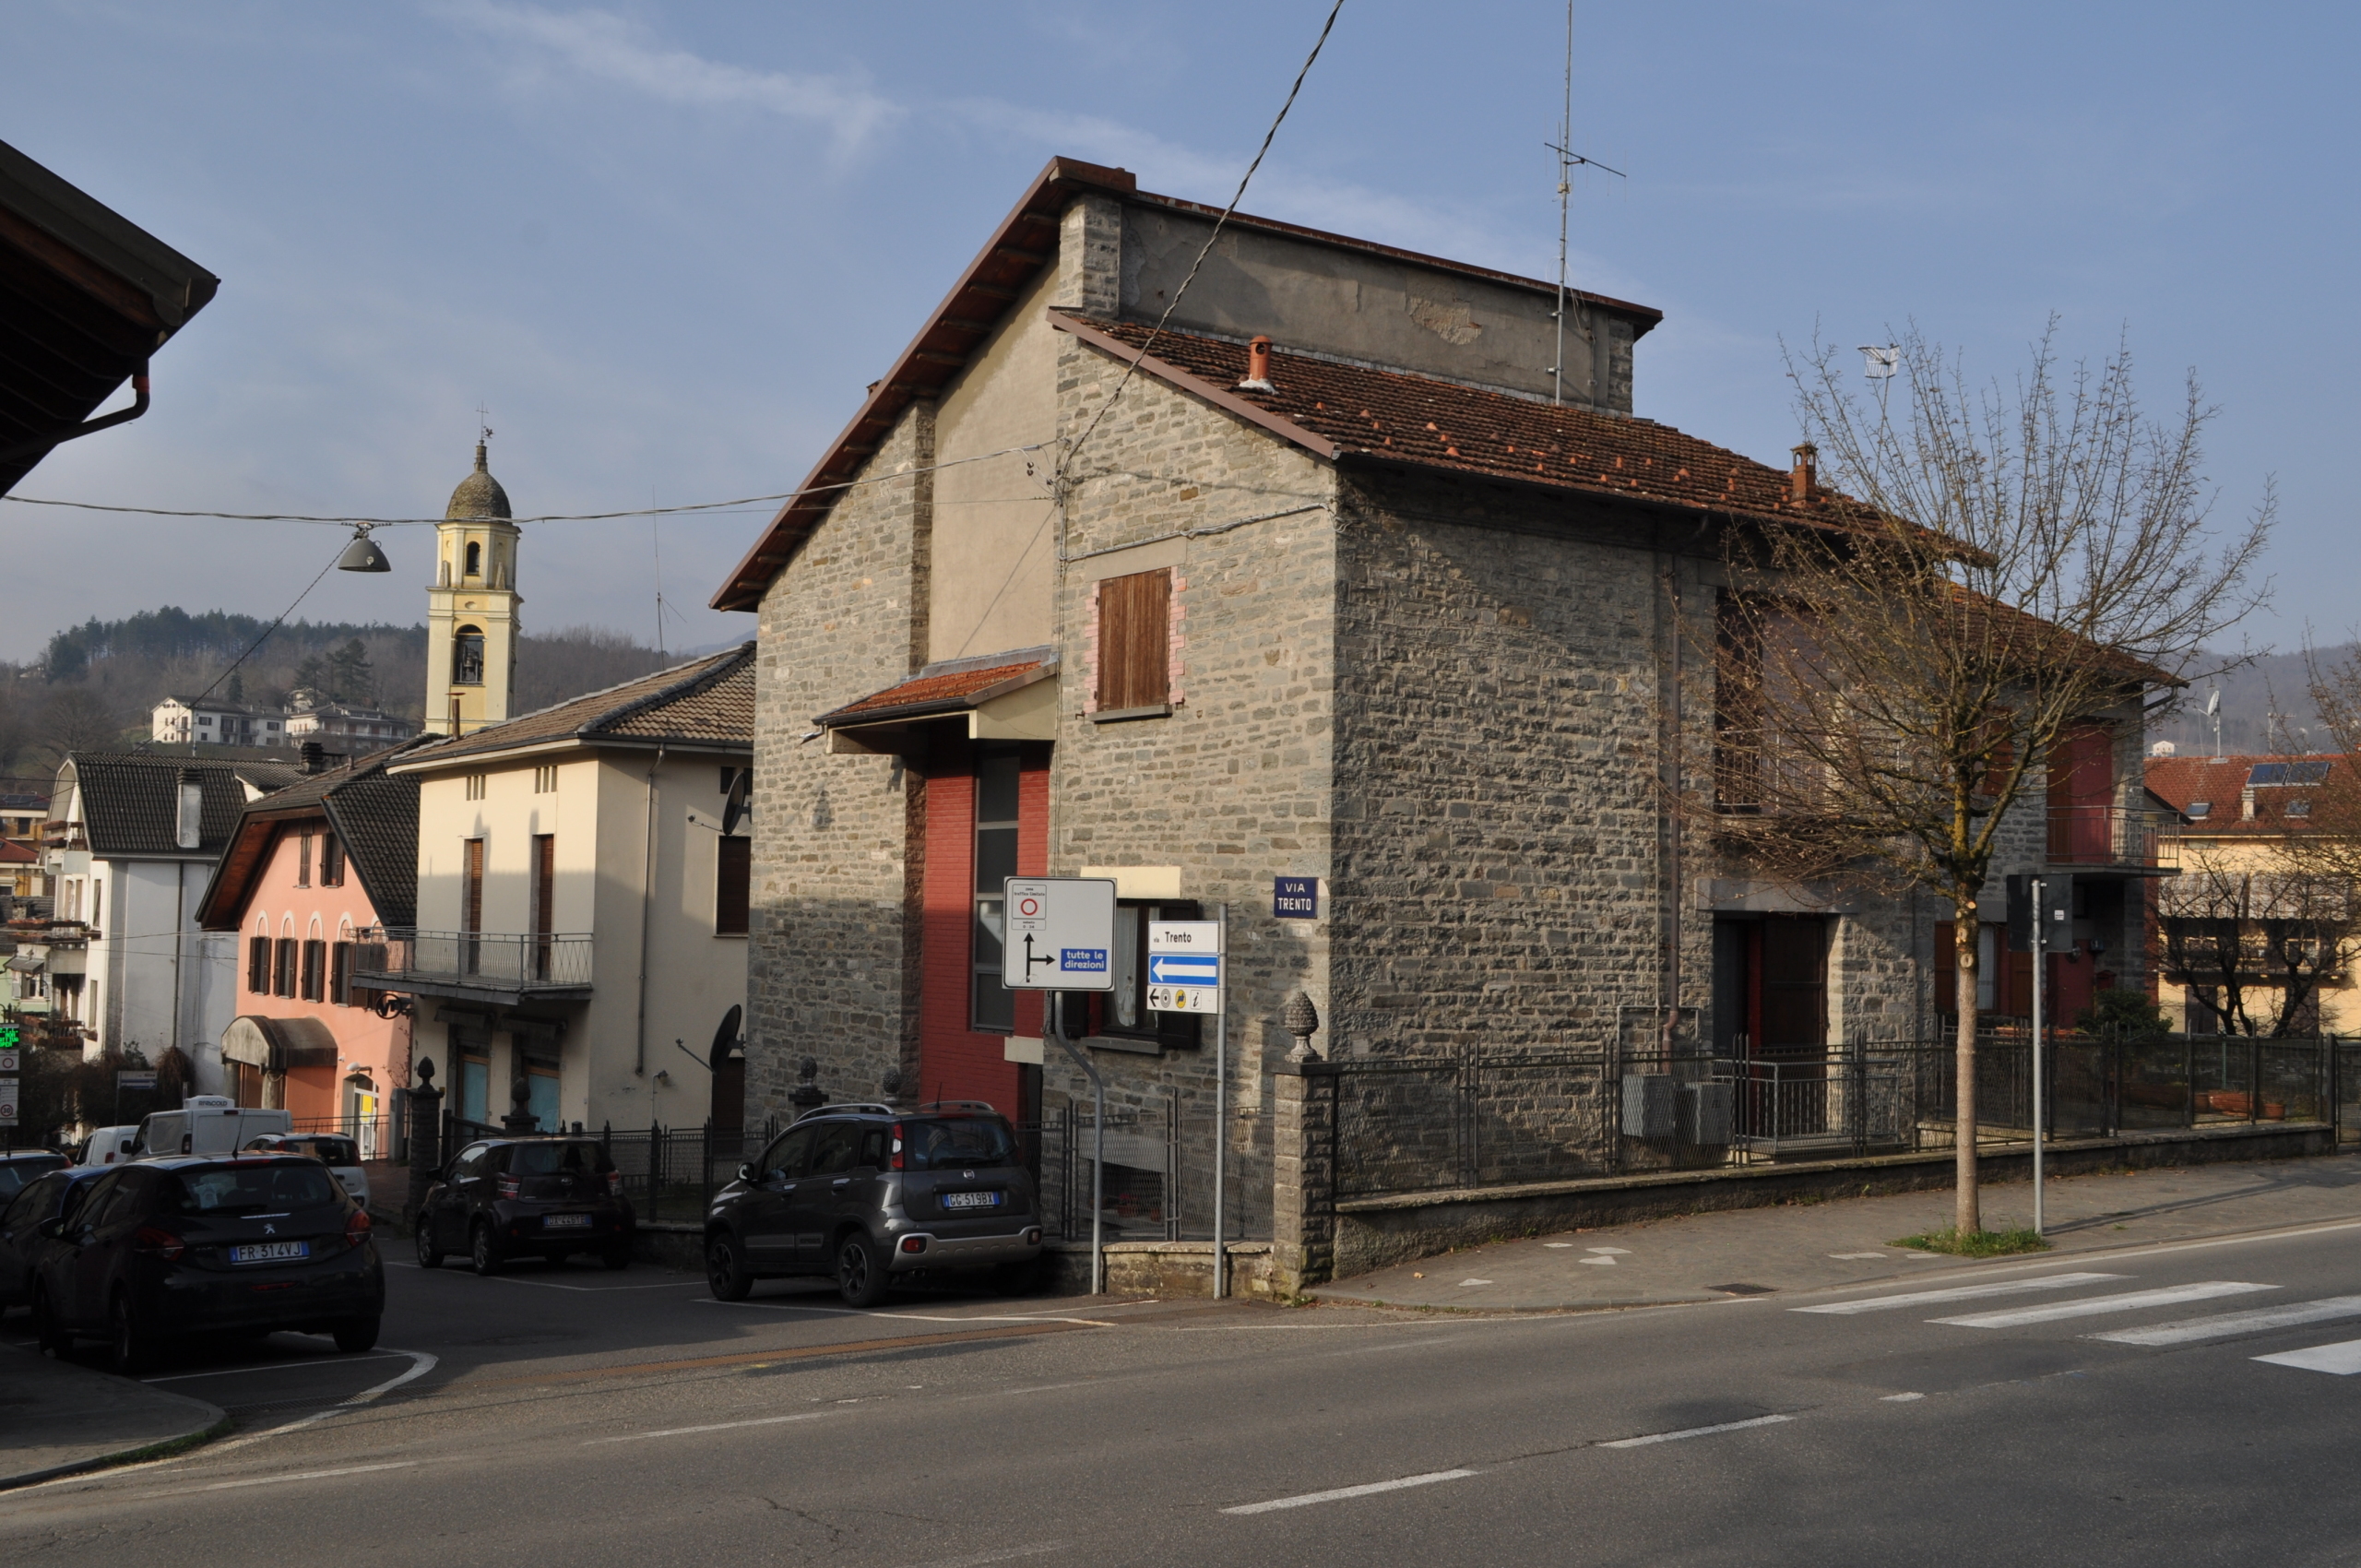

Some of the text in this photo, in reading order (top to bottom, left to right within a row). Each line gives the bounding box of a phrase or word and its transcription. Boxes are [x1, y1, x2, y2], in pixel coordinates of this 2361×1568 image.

[1285, 883, 1305, 893] VIA
[1277, 897, 1311, 911] TRENTO
[1165, 931, 1192, 943] Trento
[1066, 950, 1103, 959] tutte le
[1064, 960, 1104, 968] direzioni
